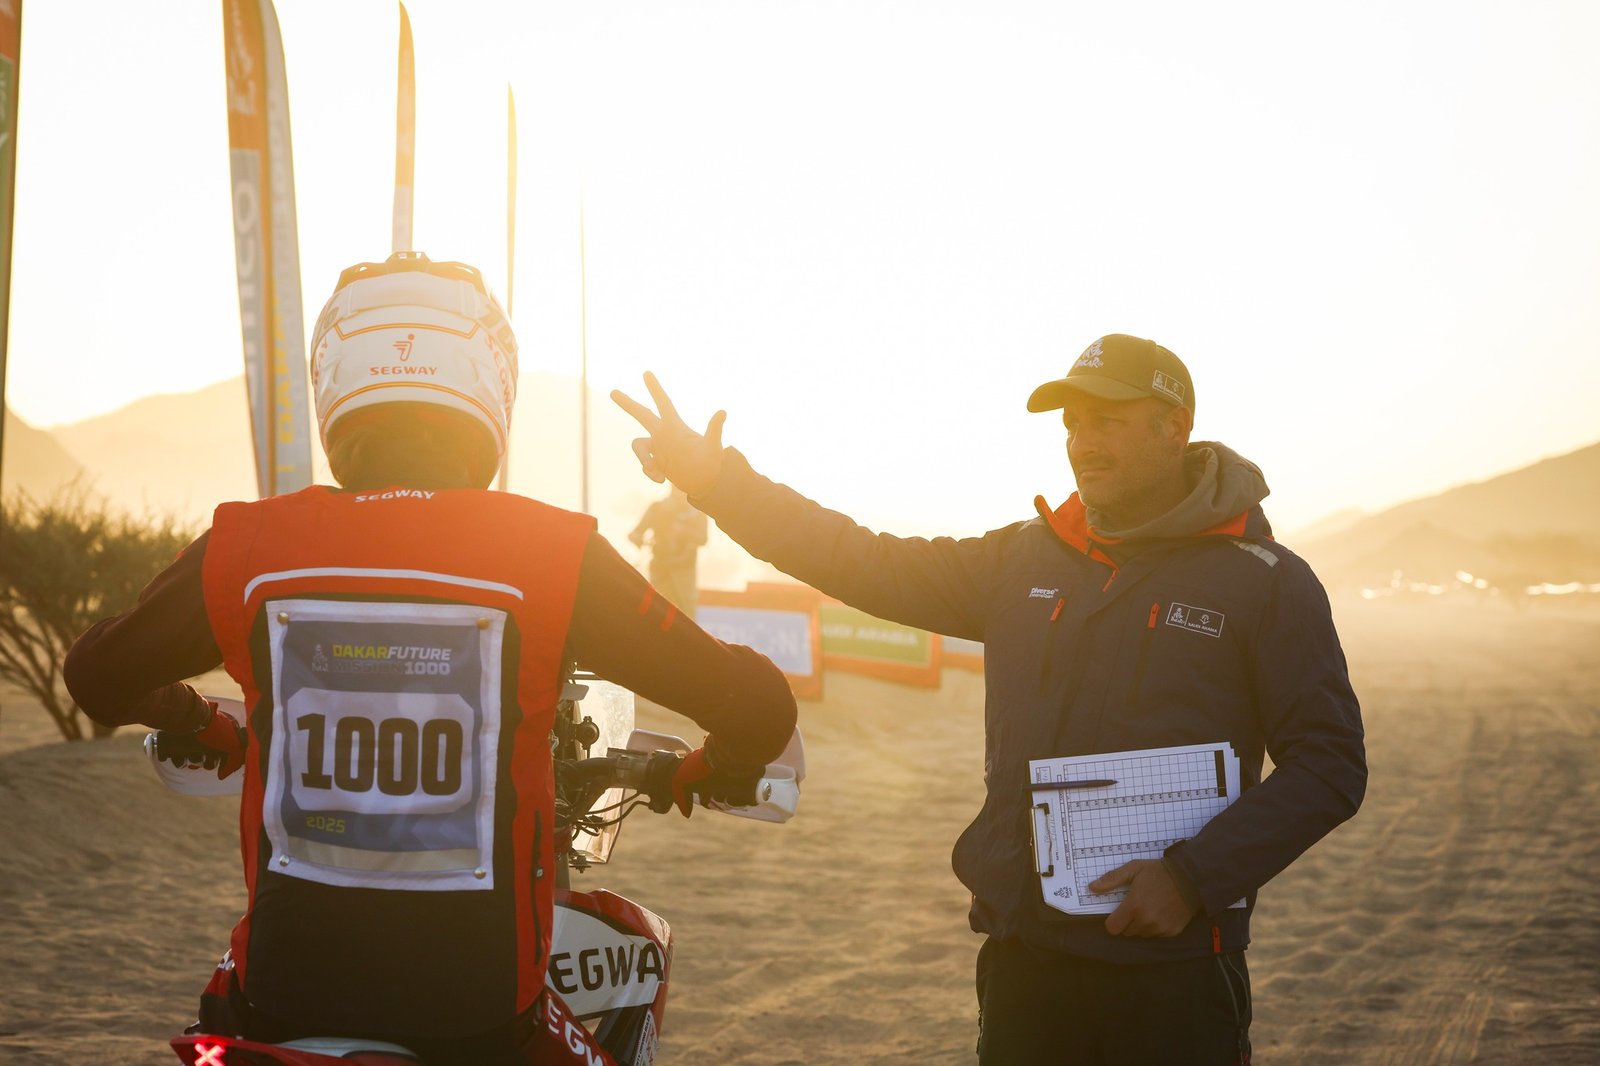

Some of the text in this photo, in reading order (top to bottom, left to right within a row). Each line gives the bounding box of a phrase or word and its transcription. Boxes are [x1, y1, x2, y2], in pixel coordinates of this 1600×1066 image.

[369, 366, 438, 376] SEGWAY
[355, 490, 436, 502] SEGWAY
[404, 661, 451, 675] 1000
[296, 712, 464, 796] 1000
[306, 815, 346, 833] 2025
